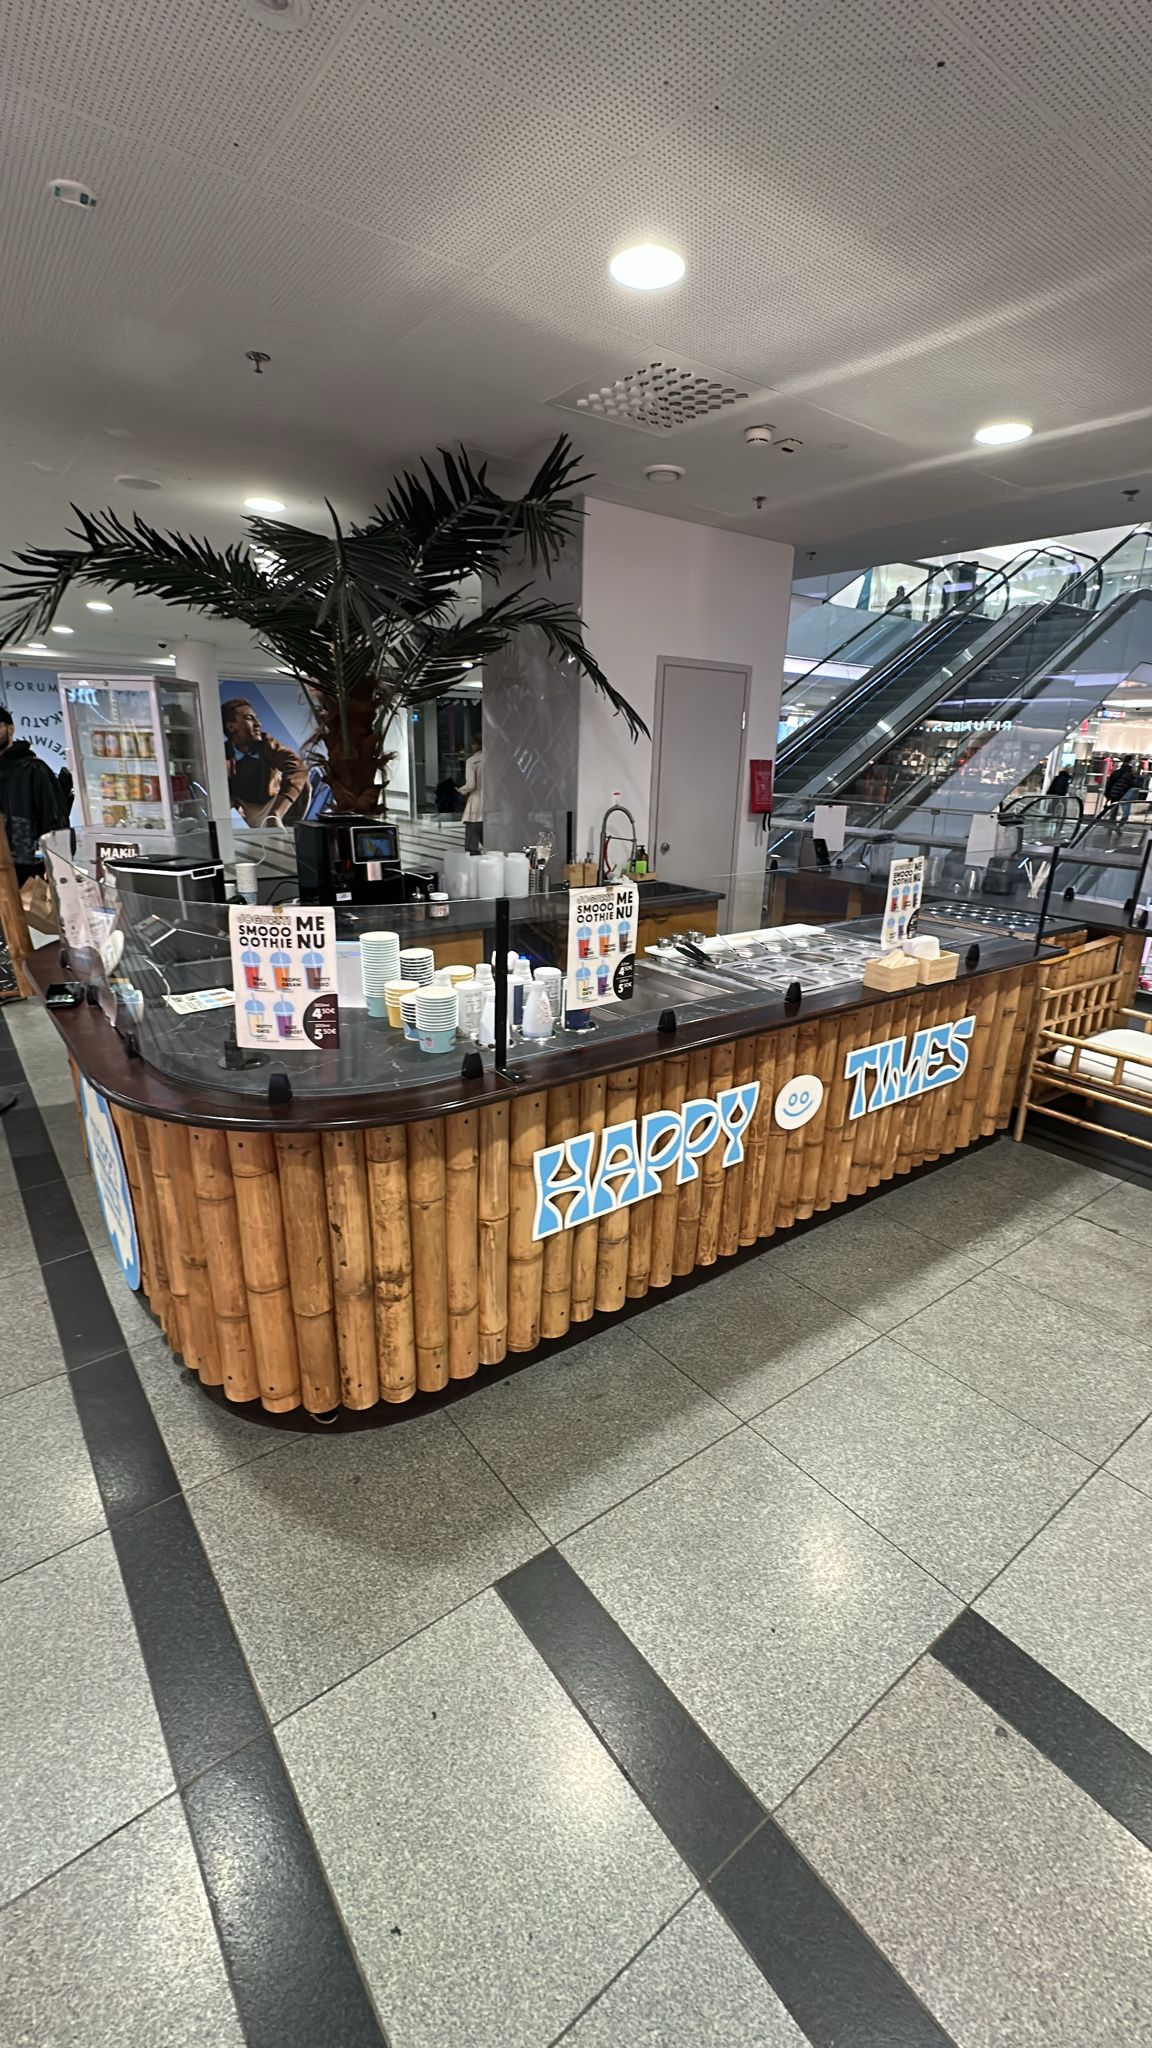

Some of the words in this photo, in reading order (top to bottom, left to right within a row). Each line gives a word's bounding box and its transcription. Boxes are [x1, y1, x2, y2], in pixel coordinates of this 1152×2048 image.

[6, 681, 58, 692] FORUM
[21, 711, 63, 728] KATU
[616, 891, 633, 905] ME
[577, 902, 614, 914] SMOOO
[616, 905, 633, 920] NU
[296, 916, 325, 932] ME
[576, 911, 614, 923] OOTHIE
[239, 925, 292, 937] SMOOO
[239, 937, 293, 948] OOTHIE
[297, 934, 325, 949] NU
[532, 1081, 760, 1242] HAPPY
[844, 1015, 977, 1121] TIMES
